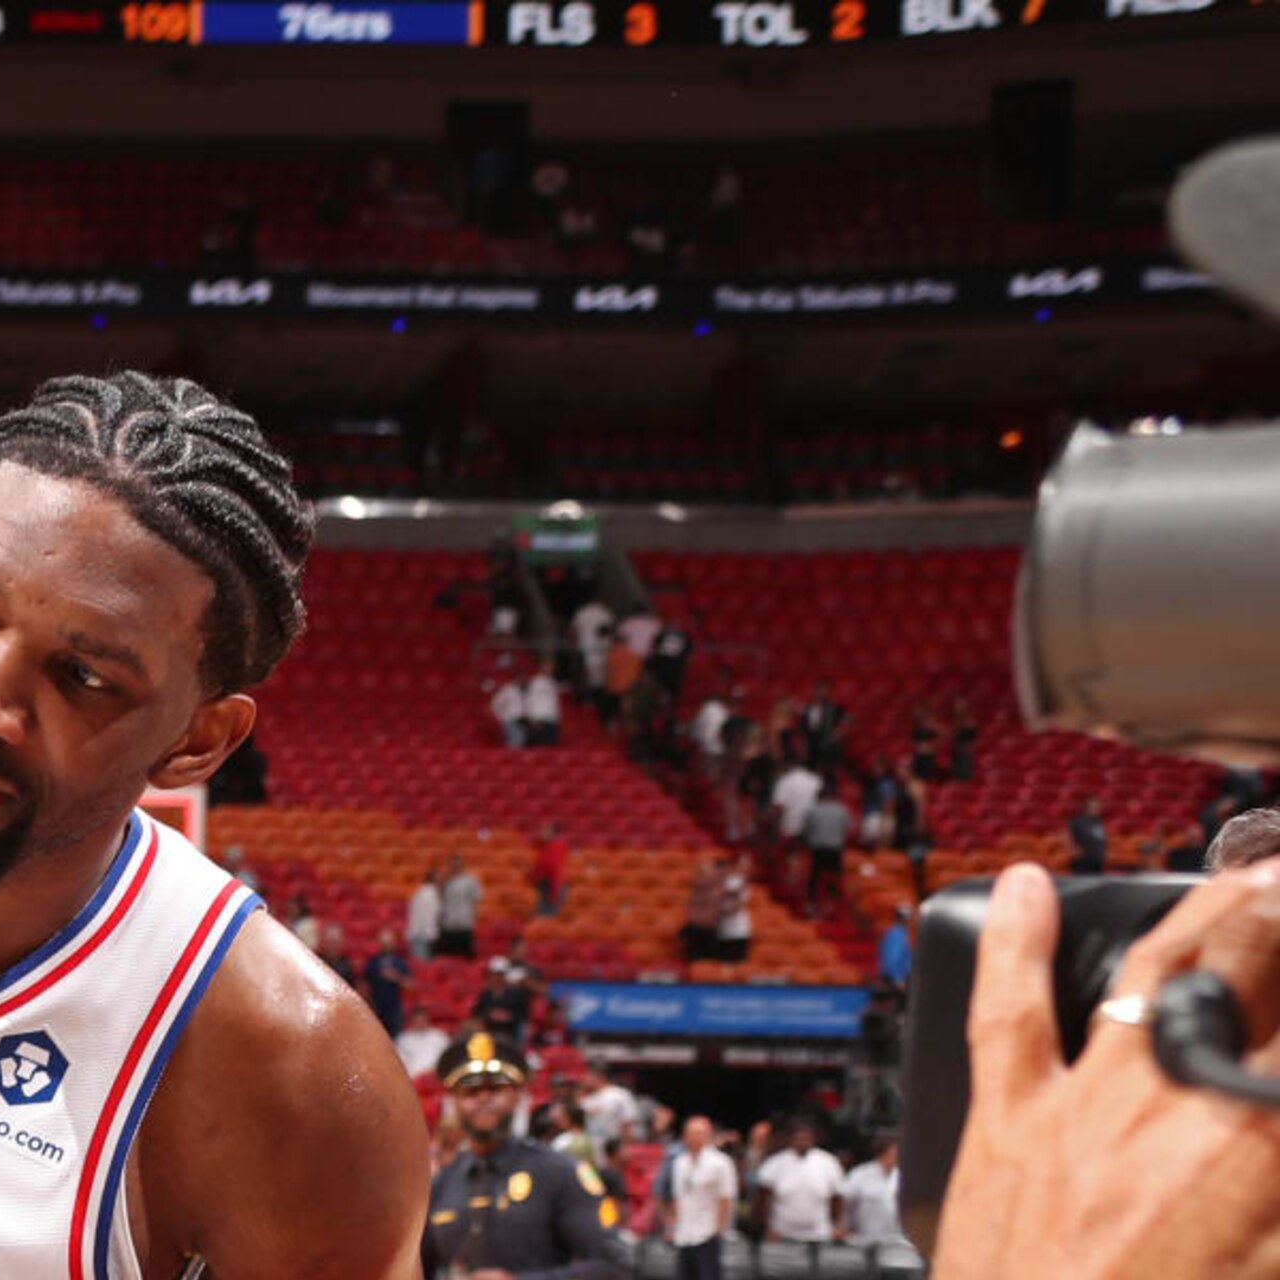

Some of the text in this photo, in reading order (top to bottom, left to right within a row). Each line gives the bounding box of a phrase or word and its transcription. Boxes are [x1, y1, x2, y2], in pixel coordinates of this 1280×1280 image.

[278, 3, 392, 41] 76ers
[507, 1, 596, 46] FLS
[624, 2, 658, 46] 3
[713, 1, 808, 47] TOL
[830, 0, 866, 41] 2
[900, 0, 999, 36] BLK
